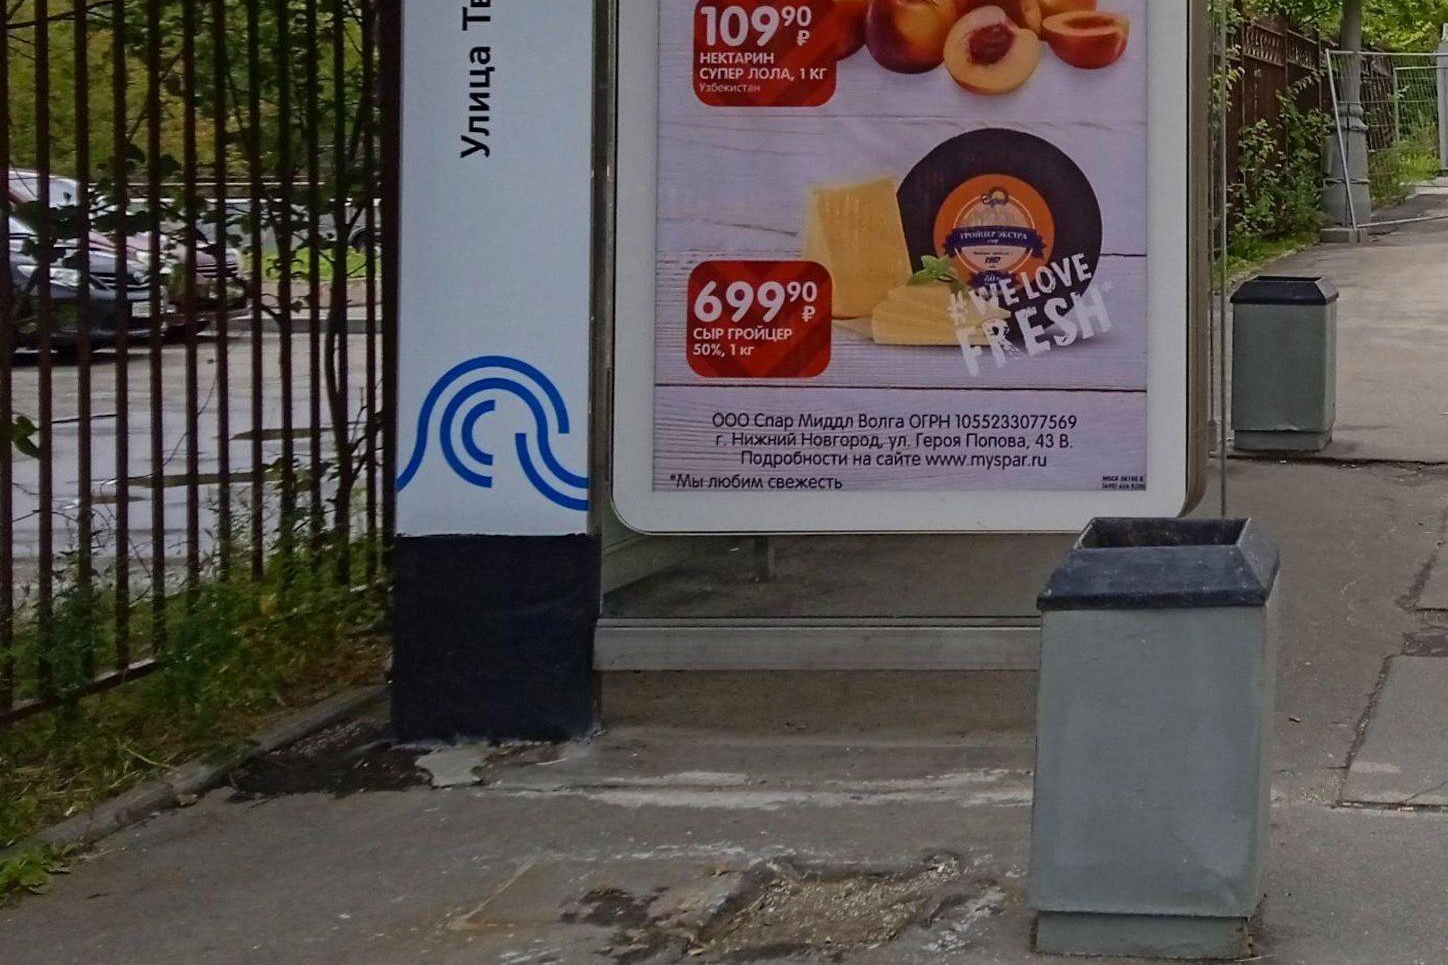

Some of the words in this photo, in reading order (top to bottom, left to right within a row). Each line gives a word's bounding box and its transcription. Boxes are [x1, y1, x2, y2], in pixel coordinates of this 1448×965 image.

[700, 5, 780, 47] 109
[781, 5, 812, 27] 90
[699, 52, 775, 65] НЕКТАРИН
[699, 67, 744, 80] СУПЕР
[748, 67, 795, 82] ЛОЛА,
[799, 67, 806, 80] 1
[809, 67, 828, 80] КГ
[699, 82, 762, 93] Узбекистан
[460, 45, 496, 158] Улица
[948, 278, 1019, 325] #WE
[1021, 253, 1092, 300] LOVE
[694, 280, 786, 323] 699
[787, 281, 818, 303] 90
[693, 327, 724, 340] СЫР
[727, 325, 792, 343] ГРОЙЦЕР
[692, 343, 726, 357] 50%,
[730, 343, 737, 356] 1
[740, 346, 755, 356] кг
[712, 412, 750, 428] ООО
[753, 412, 794, 431] Спар
[798, 413, 853, 431] Миддл
[857, 413, 904, 429] Волга
[909, 414, 950, 429] ОГРН
[955, 414, 1078, 430] 1055233077569
[716, 434, 727, 447] г.
[732, 432, 797, 446] Нижний
[801, 434, 883, 450] Новгород,
[888, 436, 911, 451] ул.
[915, 433, 961, 451] Героя
[965, 433, 1030, 450] Попова,
[1035, 433, 1054, 448] 43
[1059, 433, 1073, 449] В.
[740, 450, 848, 468] Подробности
[852, 453, 871, 466] на
[876, 451, 921, 466] сайте
[925, 453, 1047, 471] www.myspar.ru
[707, 474, 763, 489] любим
[767, 475, 844, 489] свежесть
